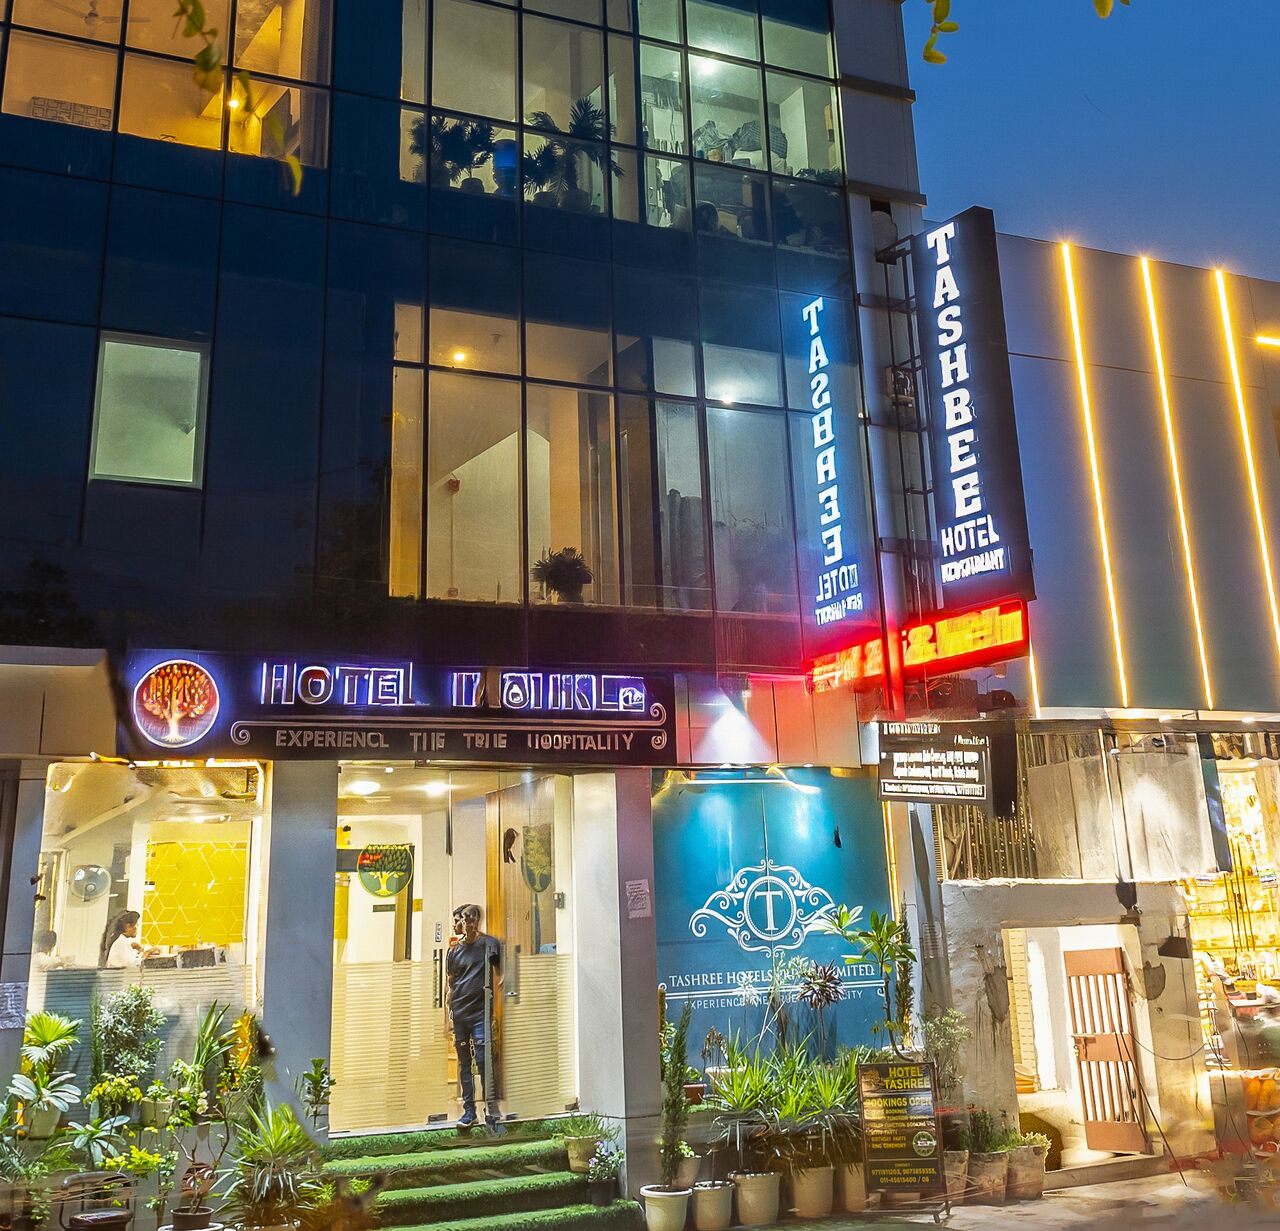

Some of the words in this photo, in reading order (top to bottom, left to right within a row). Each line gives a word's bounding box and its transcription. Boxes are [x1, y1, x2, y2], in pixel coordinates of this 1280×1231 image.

[941, 514, 1000, 557] HOTEL
[669, 973, 723, 987] TASHREE
[889, 1067, 923, 1078] HOTEL
[884, 1079, 930, 1090] TASHREE
[865, 1097, 908, 1108] BOOKINGS
[909, 1096, 932, 1106] OPEN
